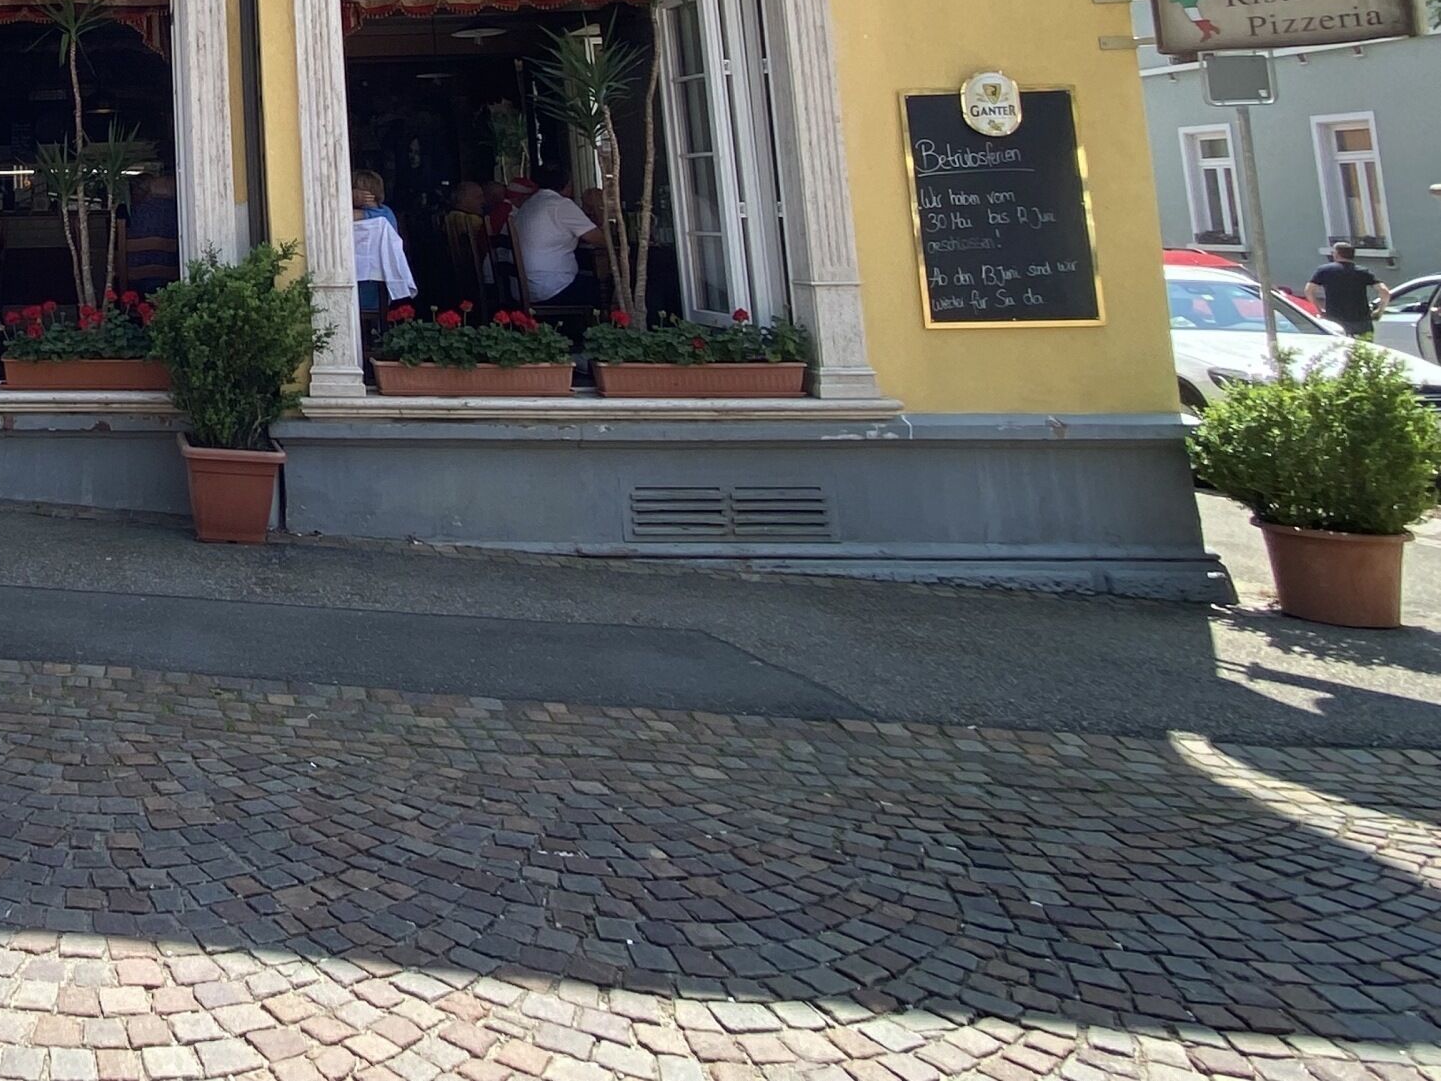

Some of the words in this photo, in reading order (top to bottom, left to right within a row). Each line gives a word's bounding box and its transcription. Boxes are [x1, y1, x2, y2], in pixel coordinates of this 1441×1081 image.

[1246, 6, 1384, 36] Pizzeria
[970, 104, 1016, 117] GANTER
[920, 187, 942, 208] Wir
[949, 189, 981, 206] haben
[987, 191, 1016, 205] vom
[988, 208, 1010, 224] bis
[929, 267, 948, 288] Ab
[1026, 262, 1052, 277] sind
[1057, 259, 1078, 273] wir
[969, 290, 988, 315] für
